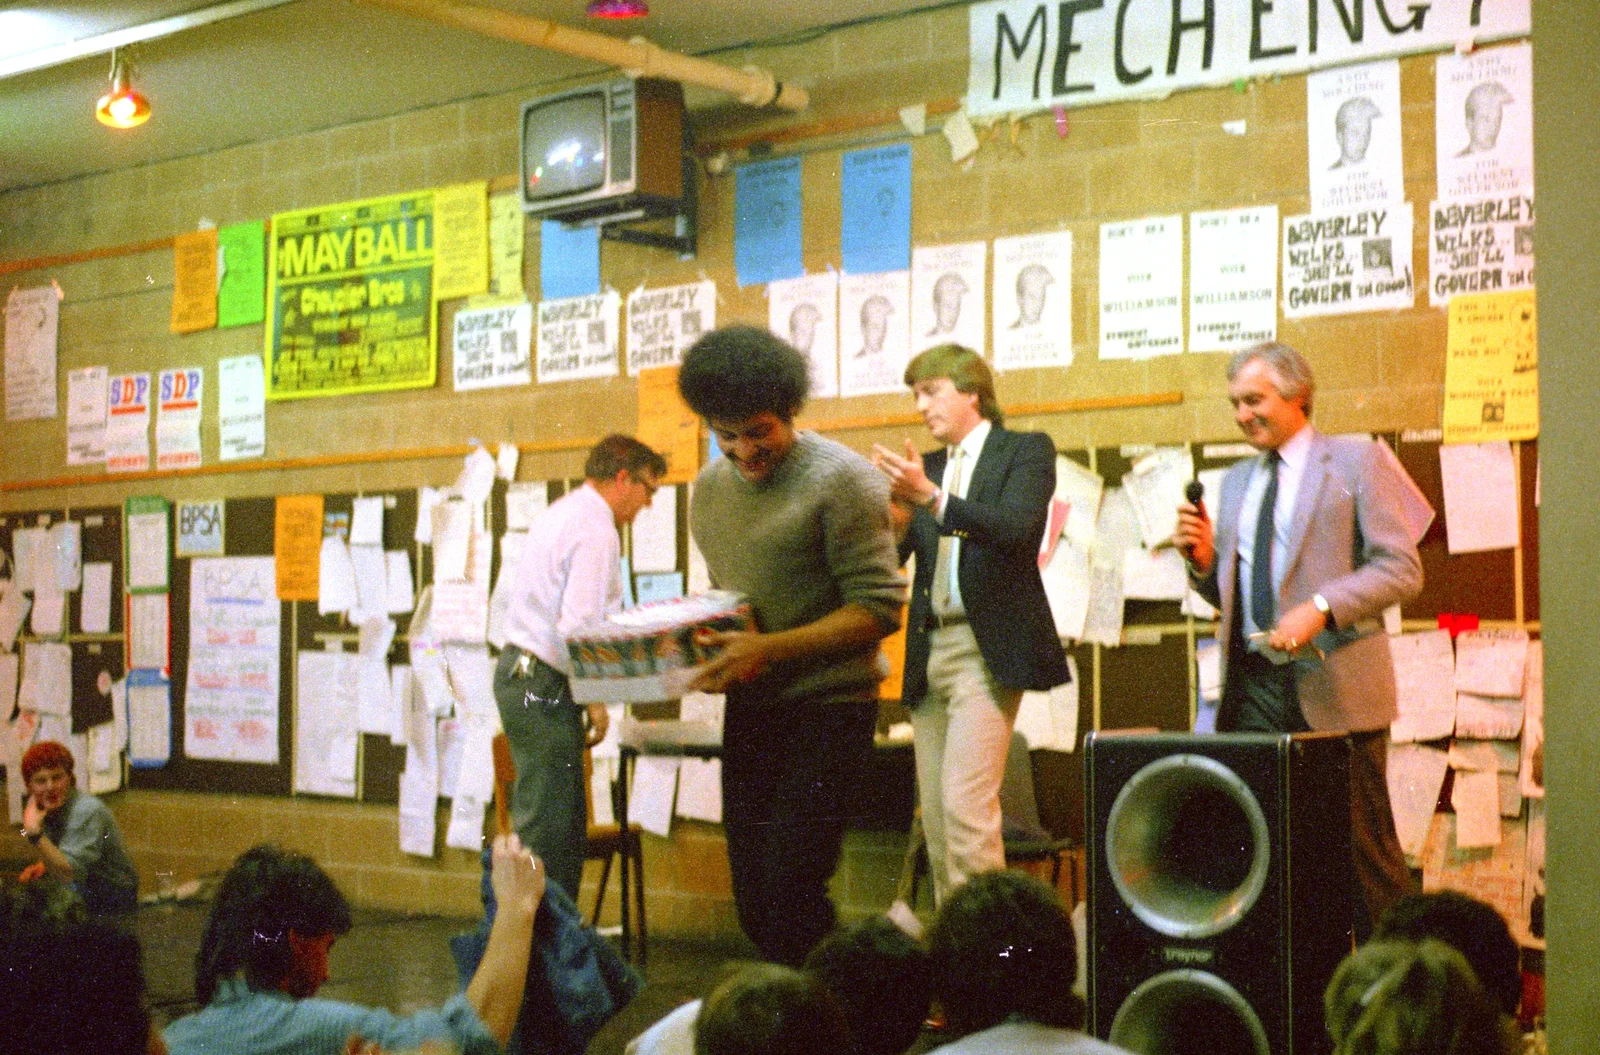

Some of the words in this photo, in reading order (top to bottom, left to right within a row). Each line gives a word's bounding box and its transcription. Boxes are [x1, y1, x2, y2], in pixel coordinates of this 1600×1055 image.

[993, 0, 1215, 99] MECH
[1287, 210, 1387, 246] BEVERLEY
[1289, 281, 1352, 310] GOVERN
[1435, 268, 1503, 297] GOVERN
[111, 375, 147, 406] SDP
[161, 371, 200, 401] SDP
[180, 503, 221, 536] BPSA
